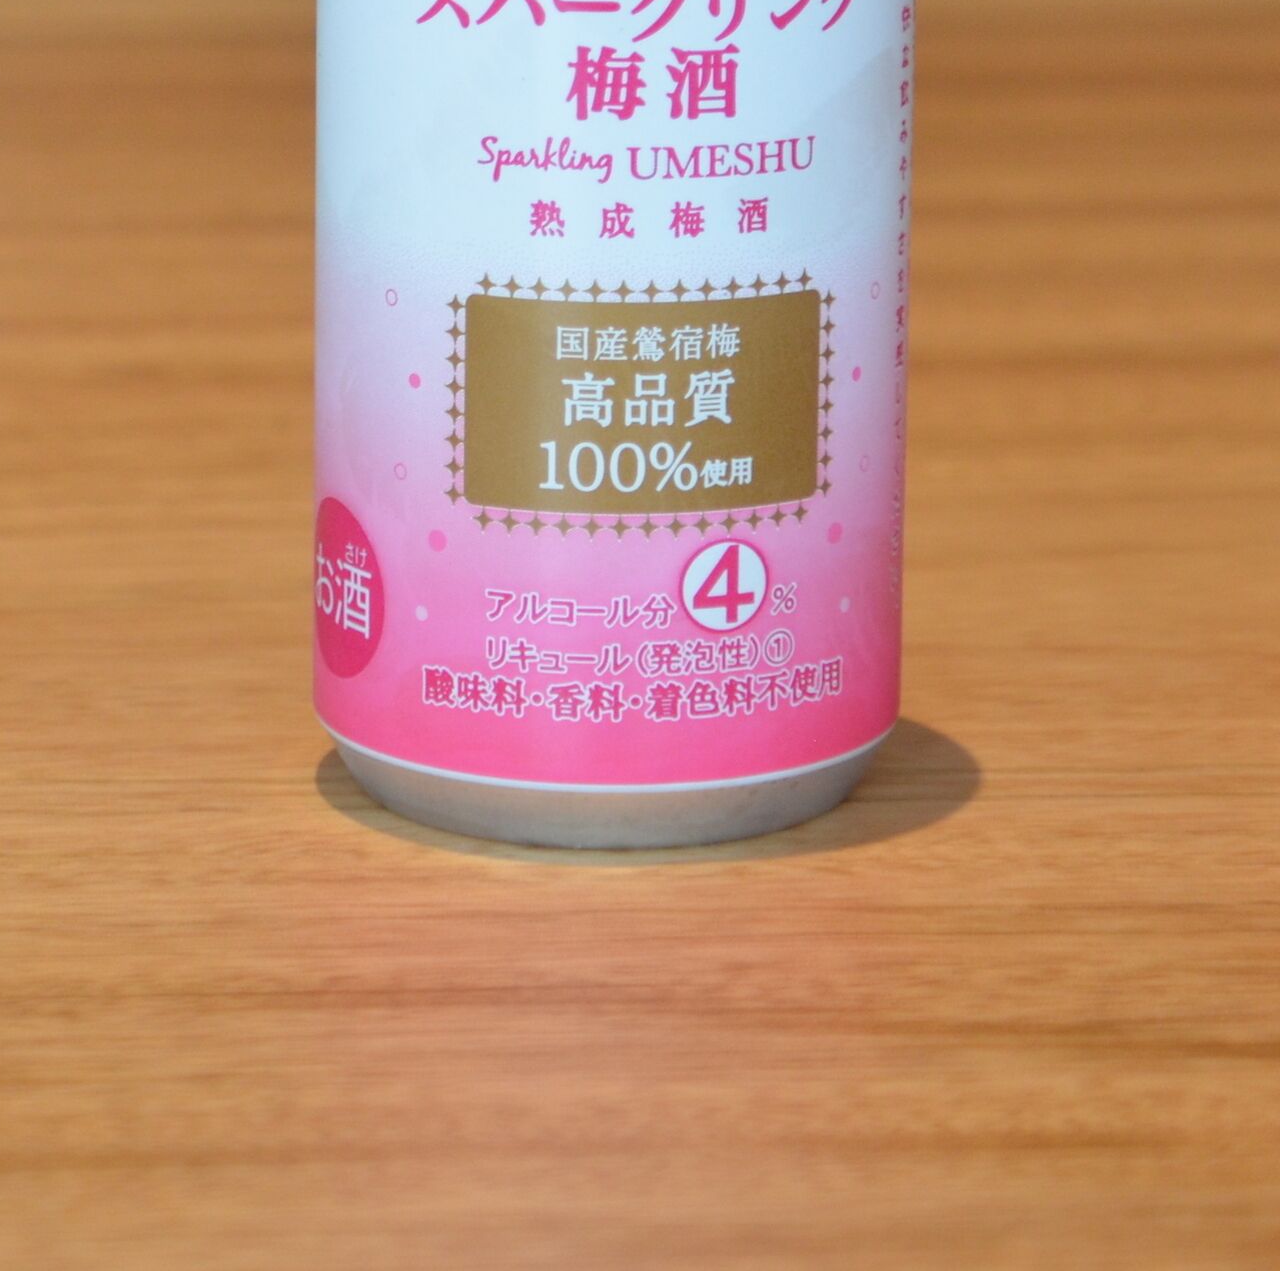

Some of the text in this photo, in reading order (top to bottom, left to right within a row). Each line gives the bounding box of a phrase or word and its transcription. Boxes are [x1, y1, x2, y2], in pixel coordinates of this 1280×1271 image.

[566, 44, 740, 121] 梅酒
[476, 136, 817, 183] Sparkling UMESHU
[530, 198, 769, 239] 熟成梅酒
[561, 368, 736, 427] 高品質
[344, 542, 368, 564] さけ
[315, 542, 373, 642] お酒
[422, 656, 843, 721] 酸味料・香料・着色料不使用
